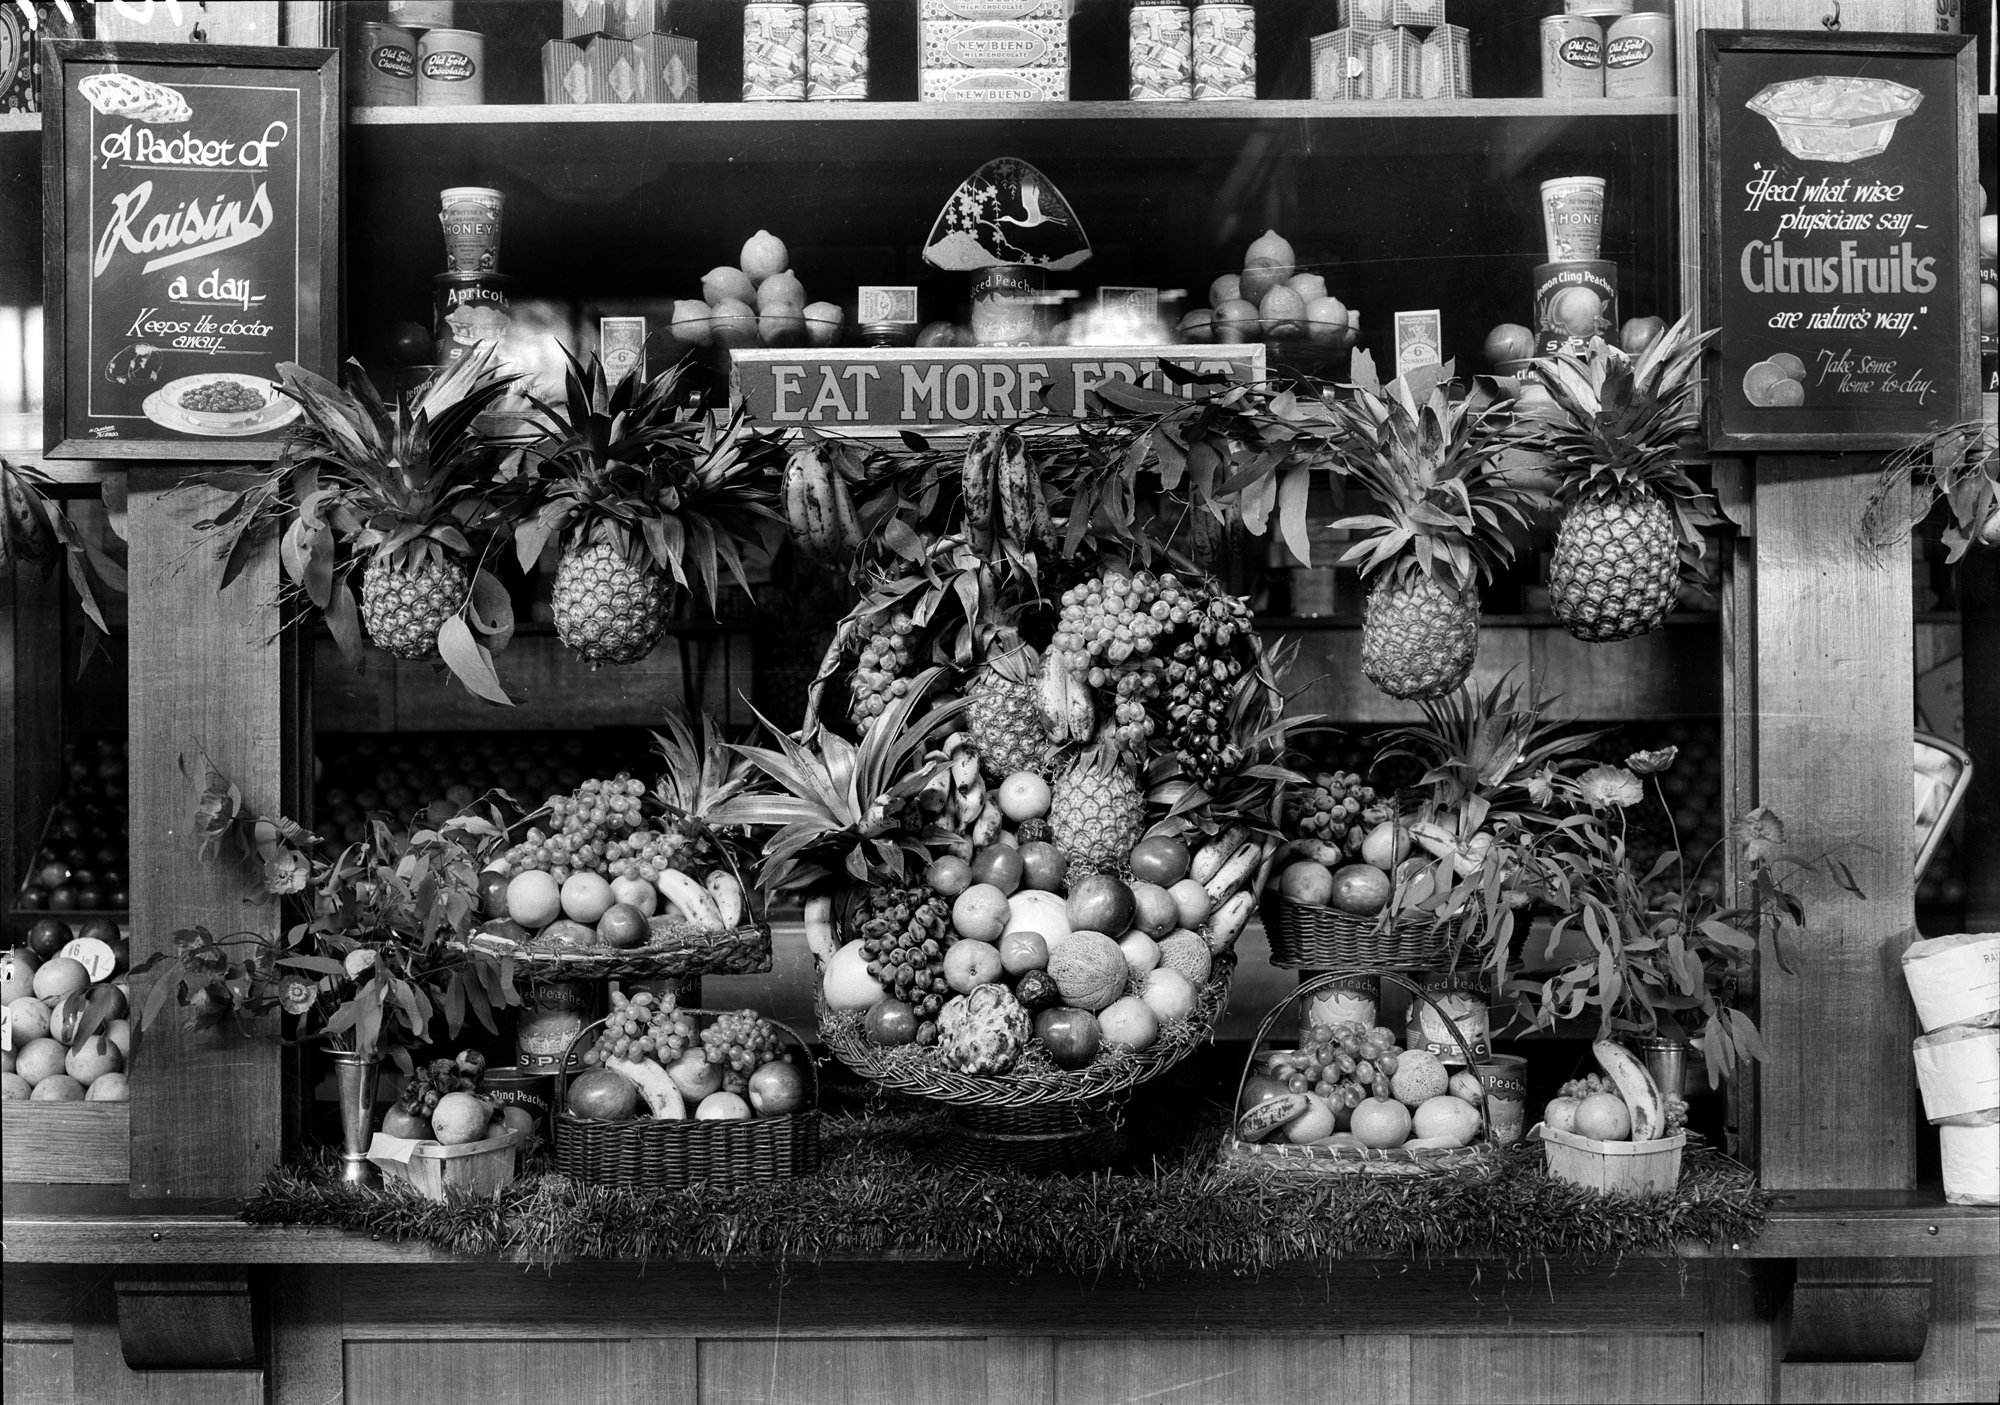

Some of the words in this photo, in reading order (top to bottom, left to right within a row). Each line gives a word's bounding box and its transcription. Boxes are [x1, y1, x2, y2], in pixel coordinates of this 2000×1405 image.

[380, 48, 397, 58] Old
[1568, 40, 1584, 50] Old
[1608, 43, 1623, 54] Old
[1622, 39, 1646, 53] Gold
[429, 55, 447, 65] Old
[445, 54, 469, 66] Gold
[1607, 51, 1649, 64] Chocolates
[427, 65, 471, 77] Chocolates
[100, 124, 132, 170] A
[136, 128, 234, 166] Packet
[238, 121, 288, 167] of
[1802, 176, 1852, 203] what
[1853, 179, 1905, 203] wise
[94, 180, 274, 278] Raisins
[446, 223, 493, 235] HONEY
[1560, 213, 1600, 225] HONE
[1771, 204, 1873, 240] physicians
[1740, 239, 1840, 293] Citrus
[167, 275, 189, 299] a
[446, 283, 510, 308] Apricots
[995, 274, 1040, 300] Peaches
[1536, 276, 1558, 302] Lemon
[1558, 270, 1583, 284] Cling
[1584, 270, 1615, 298] Peaches
[125, 307, 191, 338] Keeps
[193, 314, 218, 334] the
[219, 319, 274, 337] doctor
[1768, 311, 1804, 329] are
[1805, 305, 1872, 330] nature's
[1815, 348, 1856, 387] Take
[770, 364, 880, 422] EAT
[900, 363, 1052, 422] MORE
[1837, 372, 1875, 394] home
[539, 985, 587, 1009] Peaches
[1489, 1075, 1527, 1097] Peaches
[516, 1089, 549, 1112] Peaches
